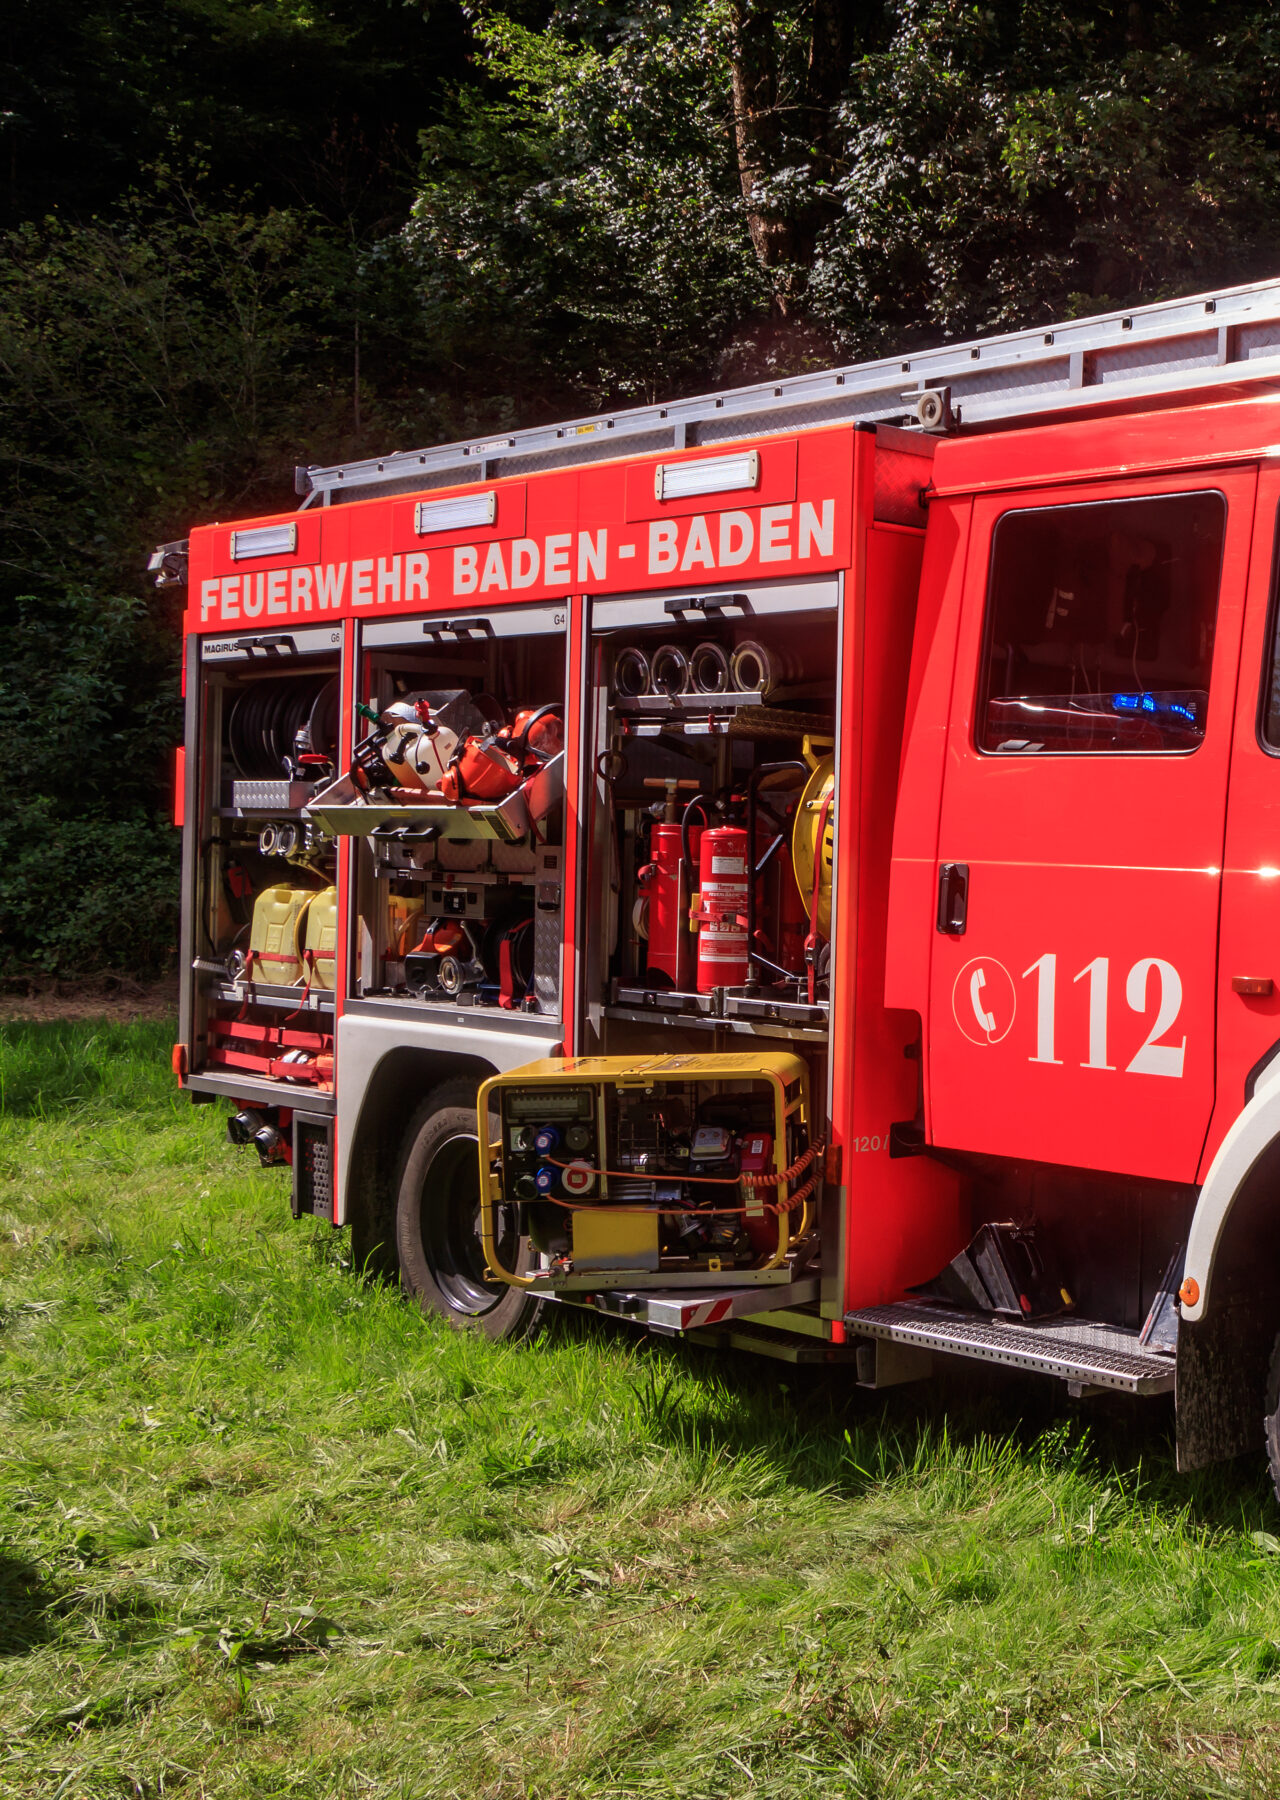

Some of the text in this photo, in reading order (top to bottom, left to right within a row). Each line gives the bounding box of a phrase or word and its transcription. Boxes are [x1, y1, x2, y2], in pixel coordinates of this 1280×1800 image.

[200, 552, 430, 622] FEUERWEHR
[554, 614, 565, 625] G4
[330, 633, 340, 643] G6
[204, 643, 239, 654] MAGIRUS
[1022, 953, 1187, 1078] 112
